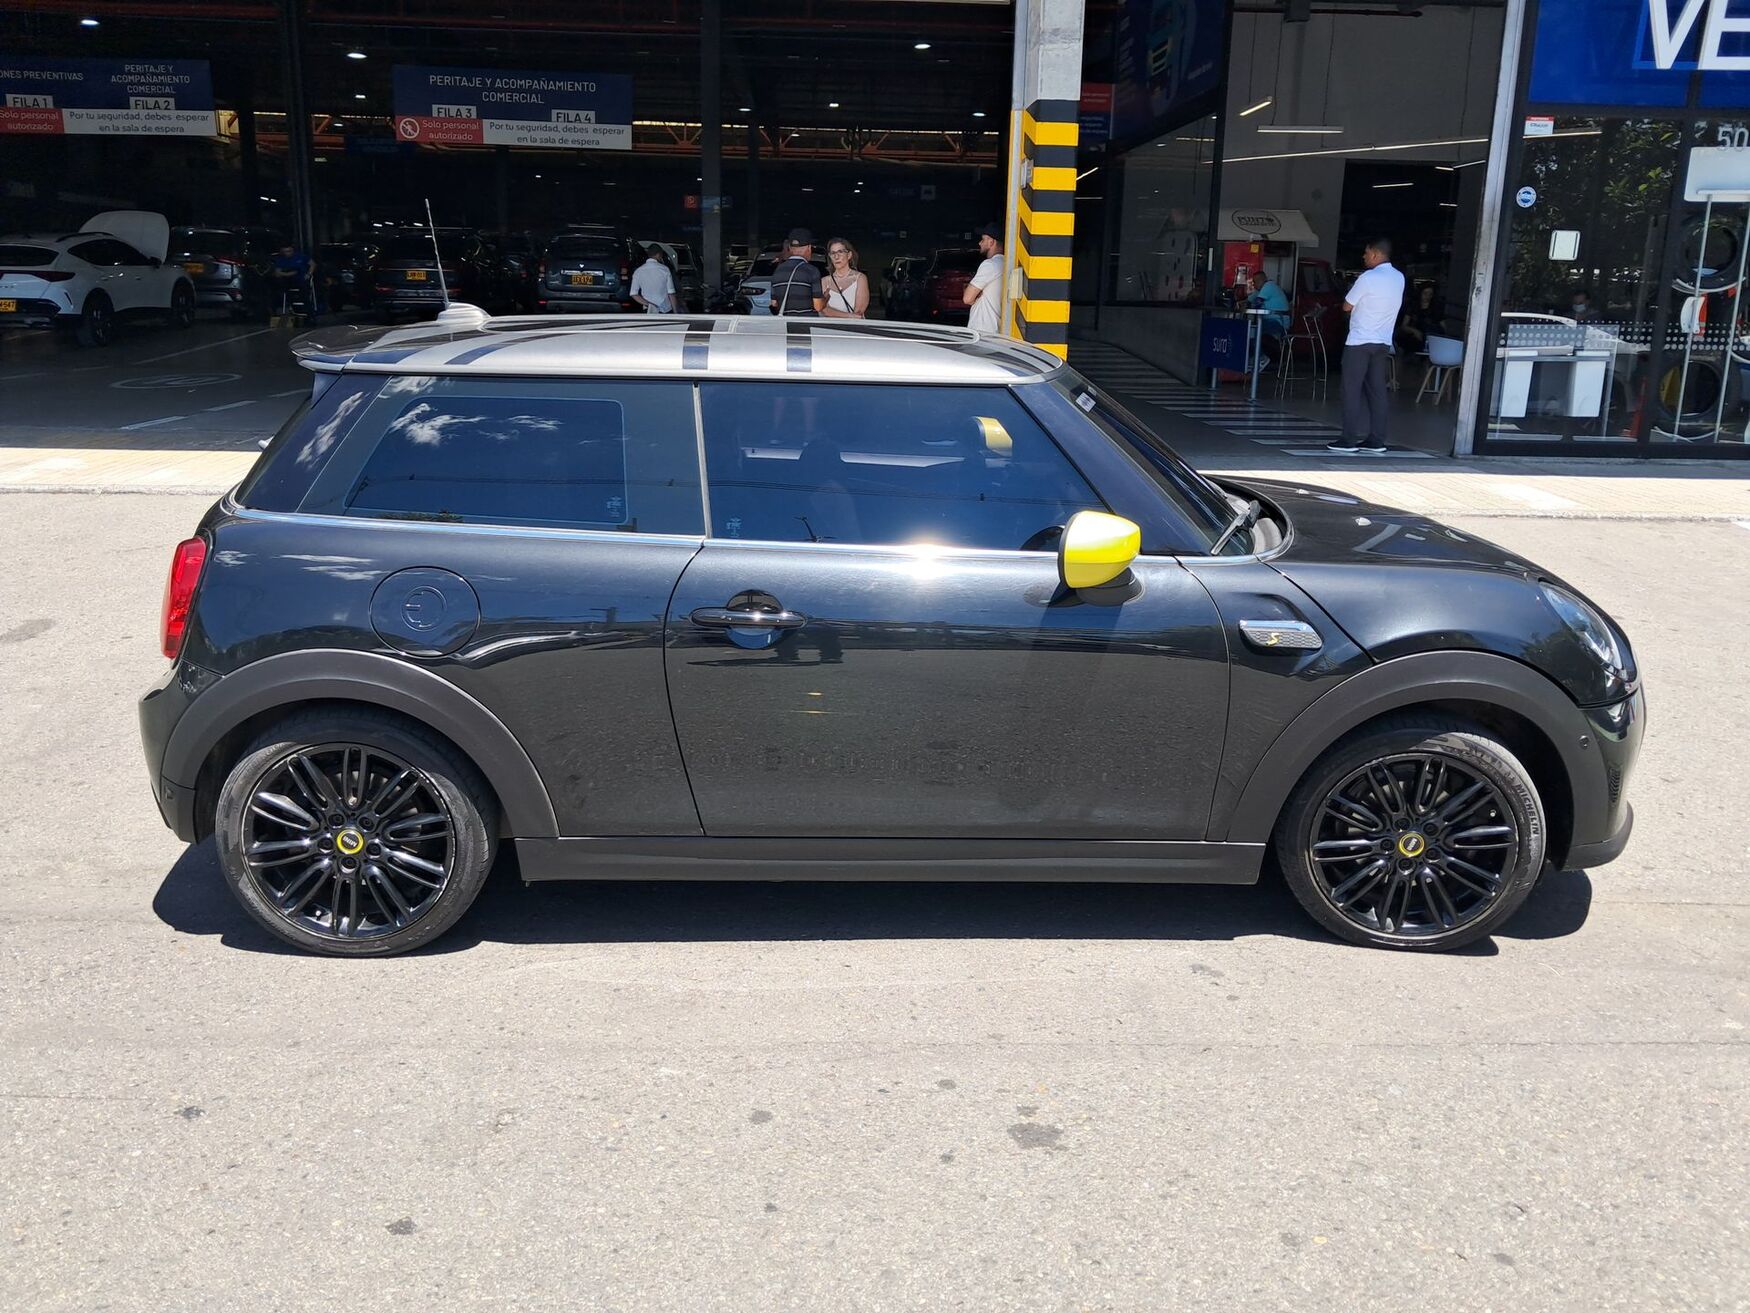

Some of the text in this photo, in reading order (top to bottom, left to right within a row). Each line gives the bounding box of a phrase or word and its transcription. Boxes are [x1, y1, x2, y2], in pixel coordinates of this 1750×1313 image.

[124, 64, 174, 74] PERITAJE Y
[23, 71, 84, 81] PREVENTIVAS
[111, 74, 190, 84] ACOMPAÑAMIENTO
[127, 85, 176, 94] COMERCIAL
[429, 75, 596, 93] PERITAJE Y ACOMPAÑAMIENTO
[13, 97, 48, 108] FILA 1
[482, 92, 545, 104] COMERCIAL
[134, 99, 170, 110] FILA 2
[0, 110, 58, 121] Solo personal
[69, 111, 84, 120] Por
[86, 112, 95, 120] tu
[145, 112, 172, 121] debes
[176, 114, 209, 123] esperar
[437, 106, 472, 118] FILA 3
[556, 112, 592, 124] FILA 4
[7, 122, 54, 131] autorizado
[112, 124, 121, 132] la
[122, 124, 140, 133] sala
[141, 125, 153, 133] de
[154, 126, 185, 134] espera
[422, 120, 480, 131] Solo personal
[489, 121, 625, 136] Por tu seguridad, debes esperar
[429, 131, 473, 141] autorizado
[529, 135, 537, 143] la
[539, 136, 556, 144] sala
[558, 135, 569, 144] de
[571, 137, 600, 146] espera
[1516, 783, 1540, 836] MICHELIN
